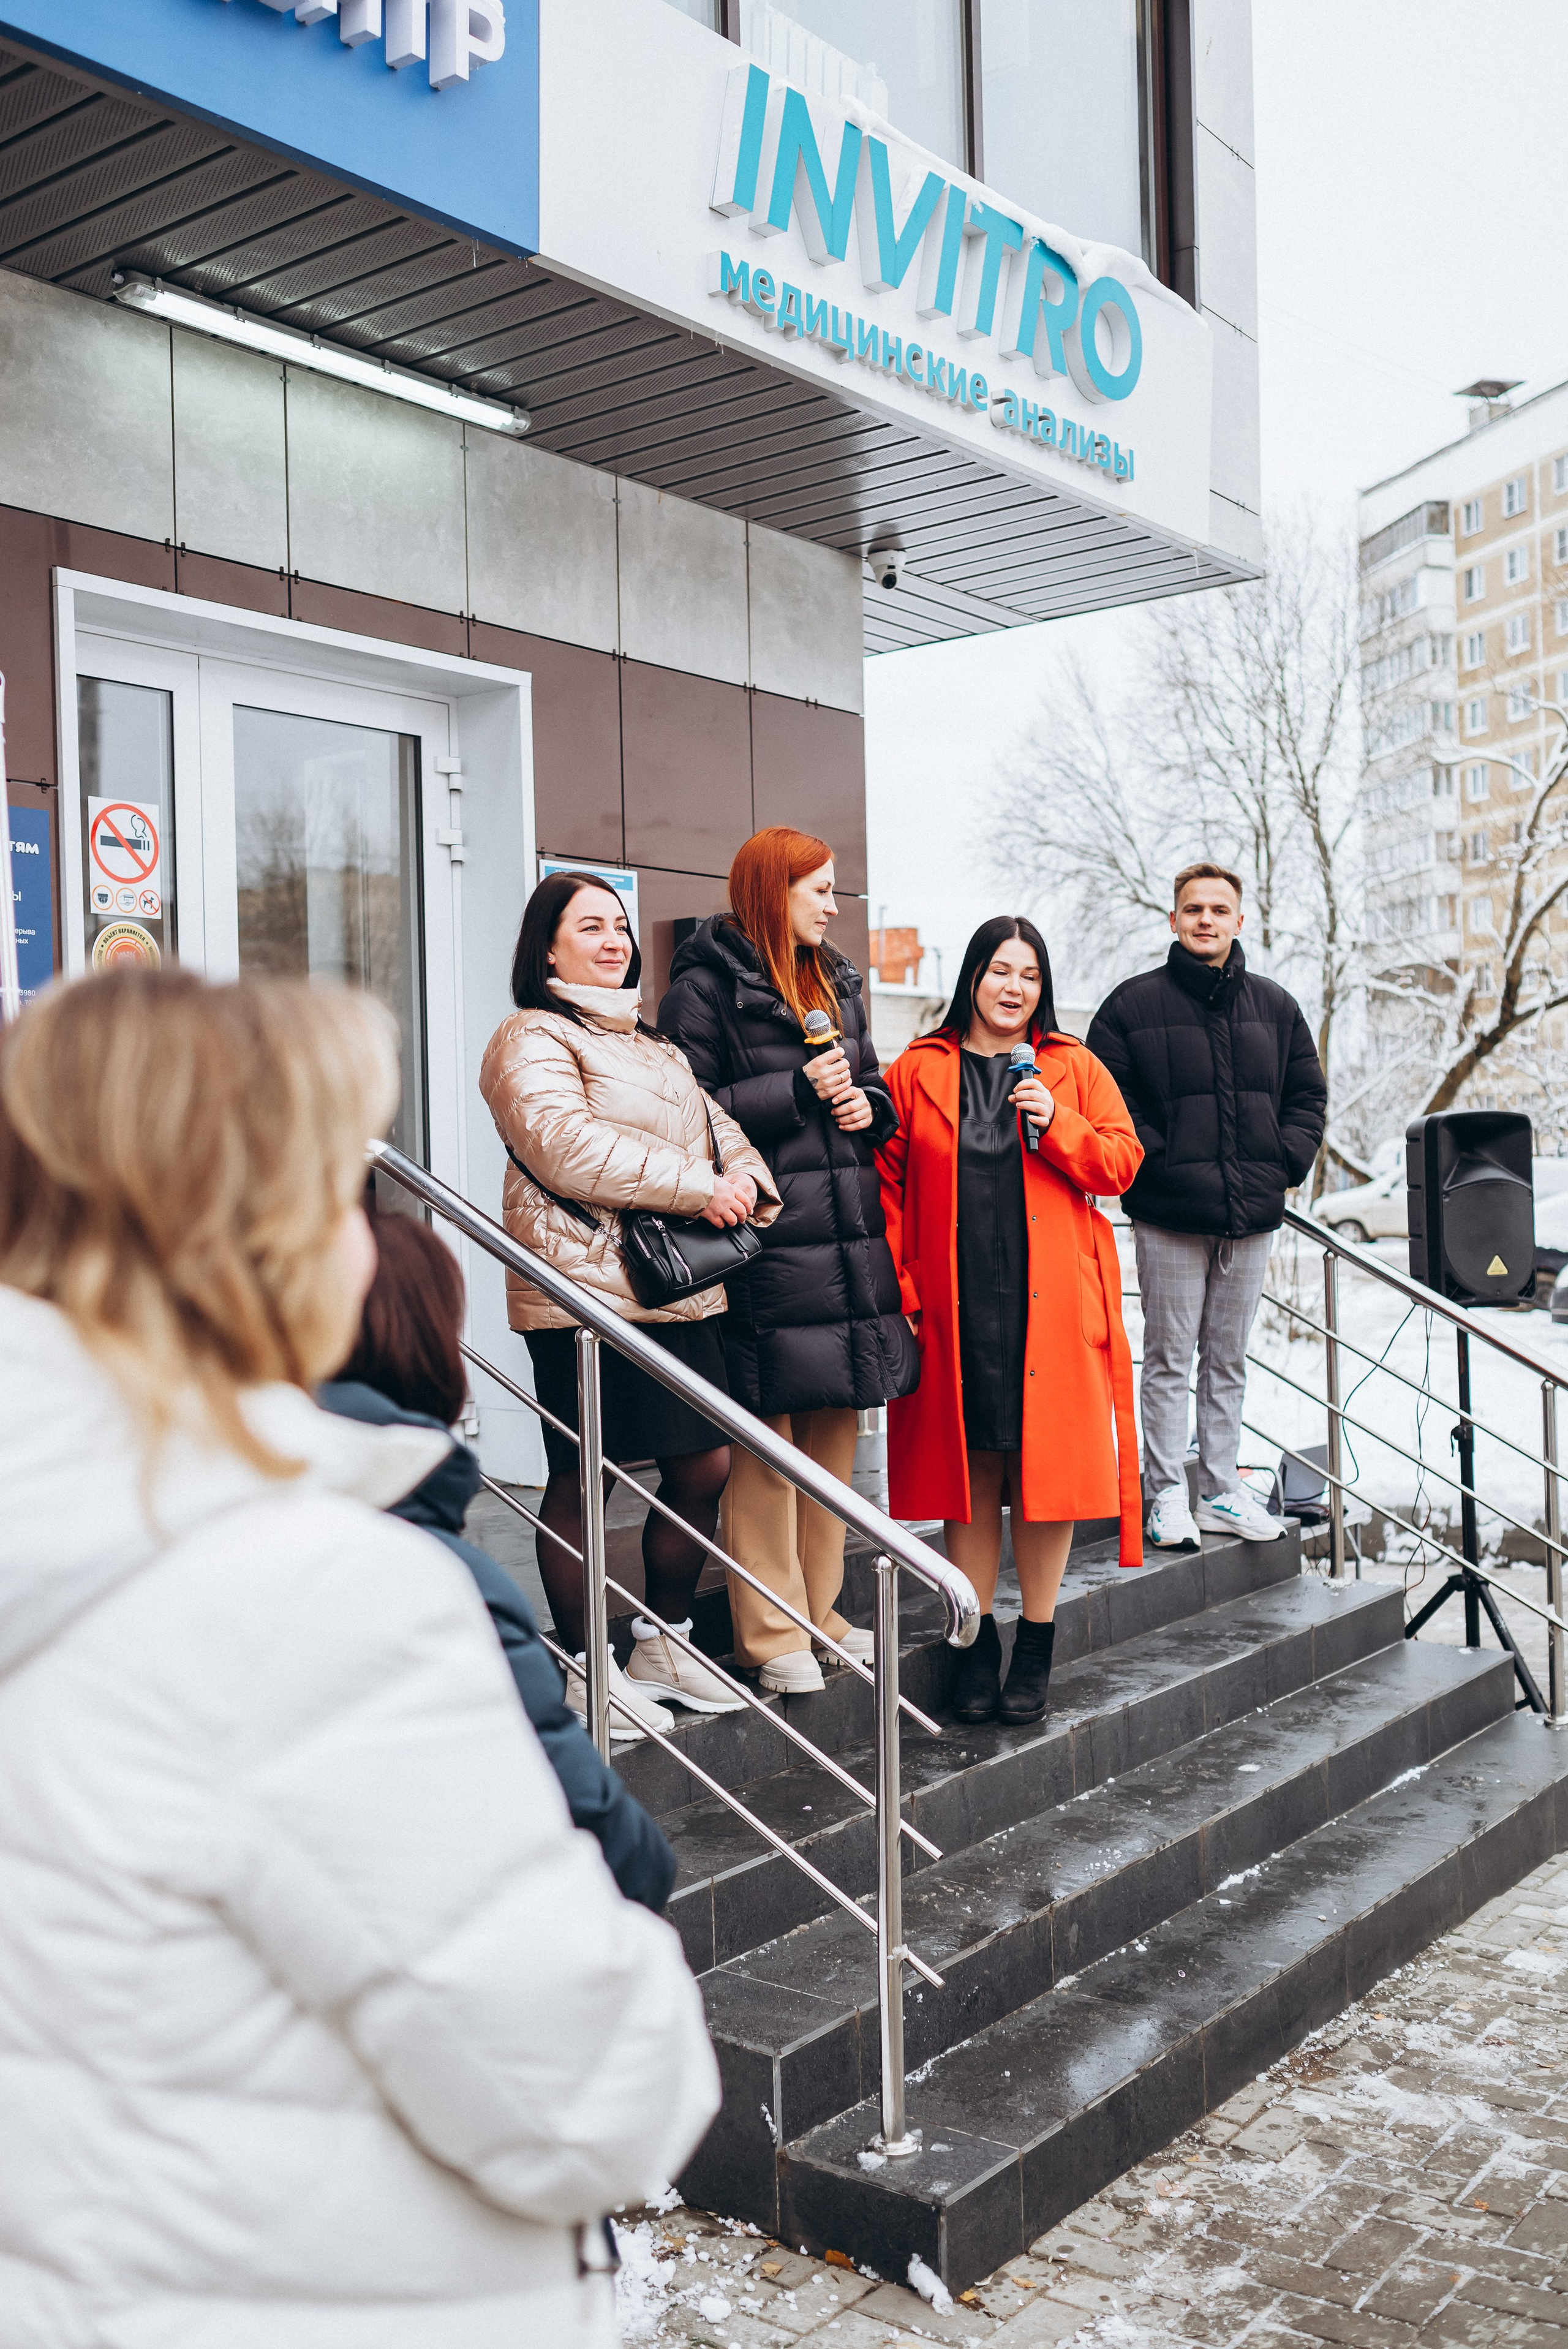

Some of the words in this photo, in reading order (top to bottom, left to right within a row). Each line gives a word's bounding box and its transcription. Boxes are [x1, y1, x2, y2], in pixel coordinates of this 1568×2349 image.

[731, 62, 1143, 402] INVITRO
[719, 249, 990, 413] медицинские
[1002, 387, 1136, 483] анализы
[103, 929, 118, 944] ОБЪЕКТ
[118, 928, 146, 941] ОХРАНЯЕТСЯ
